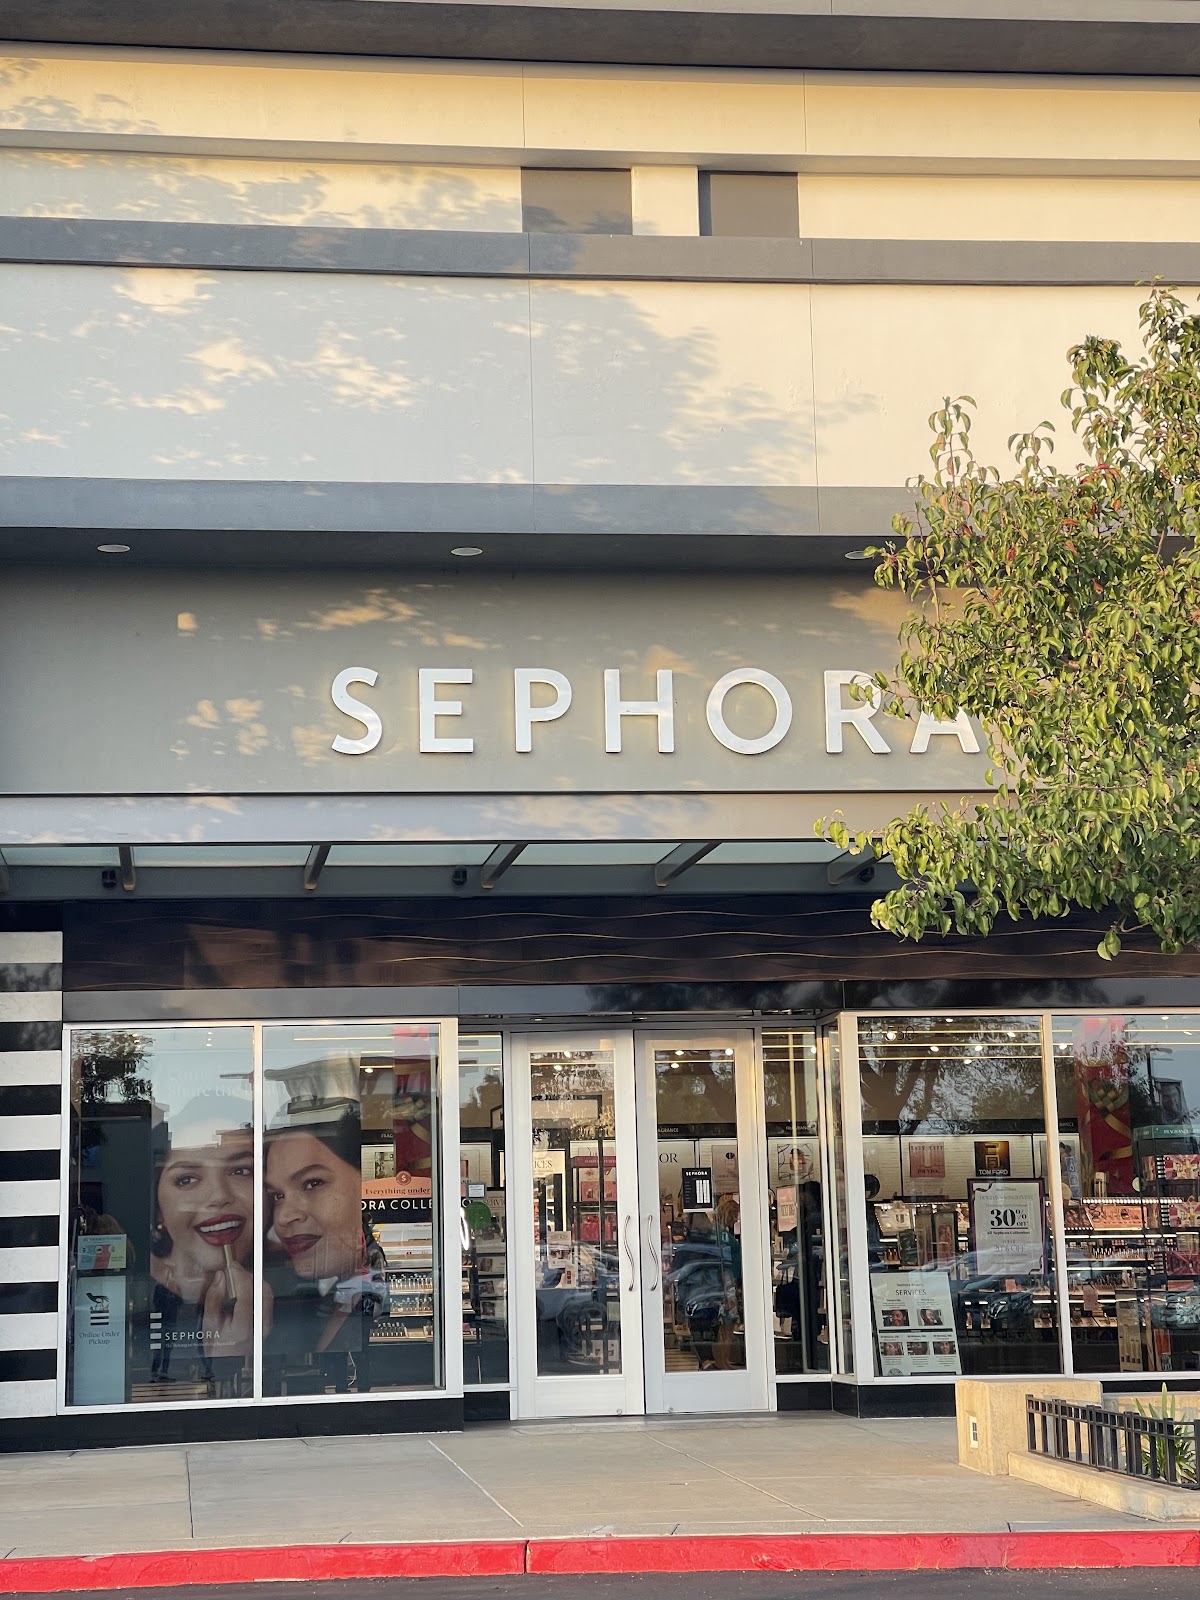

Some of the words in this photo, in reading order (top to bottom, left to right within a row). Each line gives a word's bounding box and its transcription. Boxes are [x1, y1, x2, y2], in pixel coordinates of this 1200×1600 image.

[331, 666, 981, 755] SEPHORA
[365, 1187, 406, 1195] Everything
[408, 1187, 430, 1195] under
[101, 1330, 120, 1338] Order
[165, 1330, 220, 1341] SEPHORA
